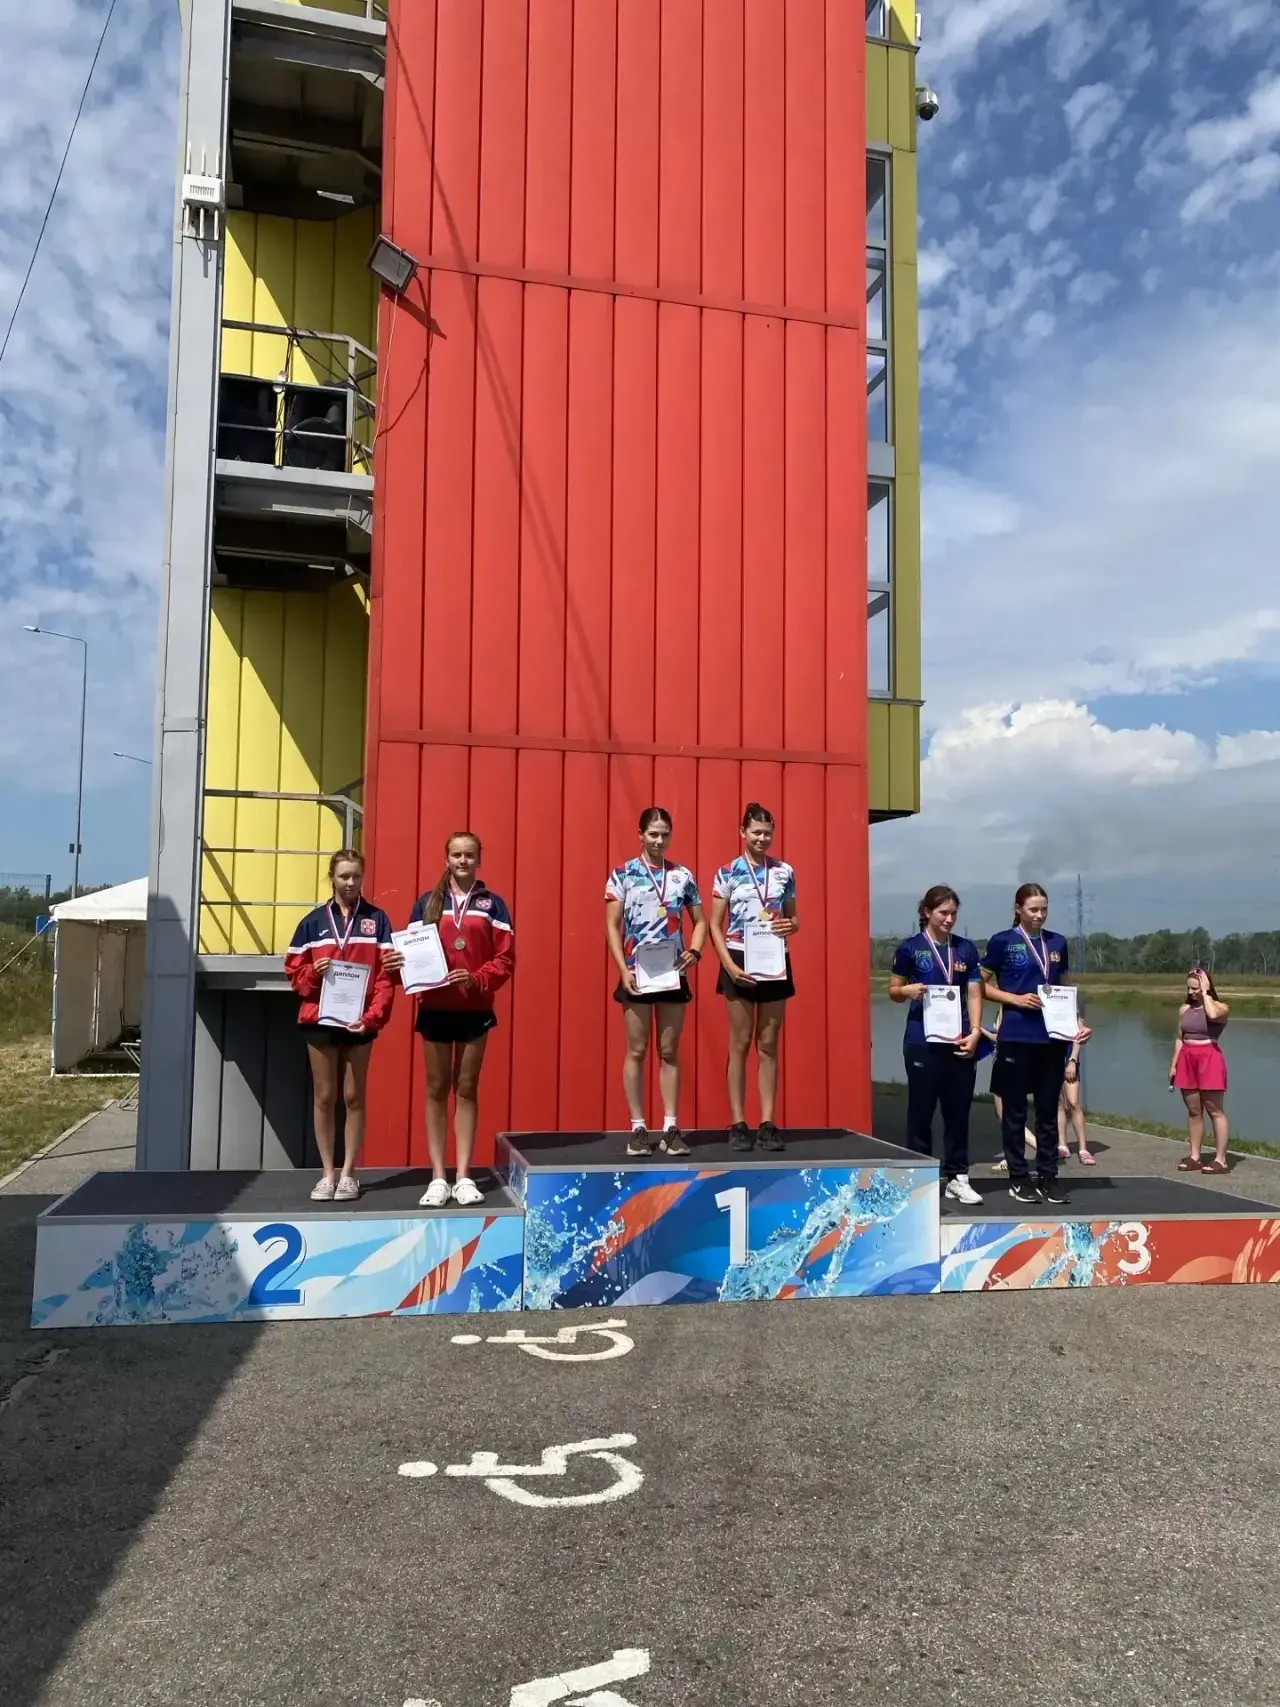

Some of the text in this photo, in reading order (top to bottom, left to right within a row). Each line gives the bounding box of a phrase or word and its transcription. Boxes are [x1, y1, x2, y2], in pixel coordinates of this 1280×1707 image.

[333, 971, 361, 979] ДИПЛОМ
[714, 1186, 750, 1268] 1
[1117, 1221, 1151, 1275] 3
[247, 1223, 307, 1307] 2
